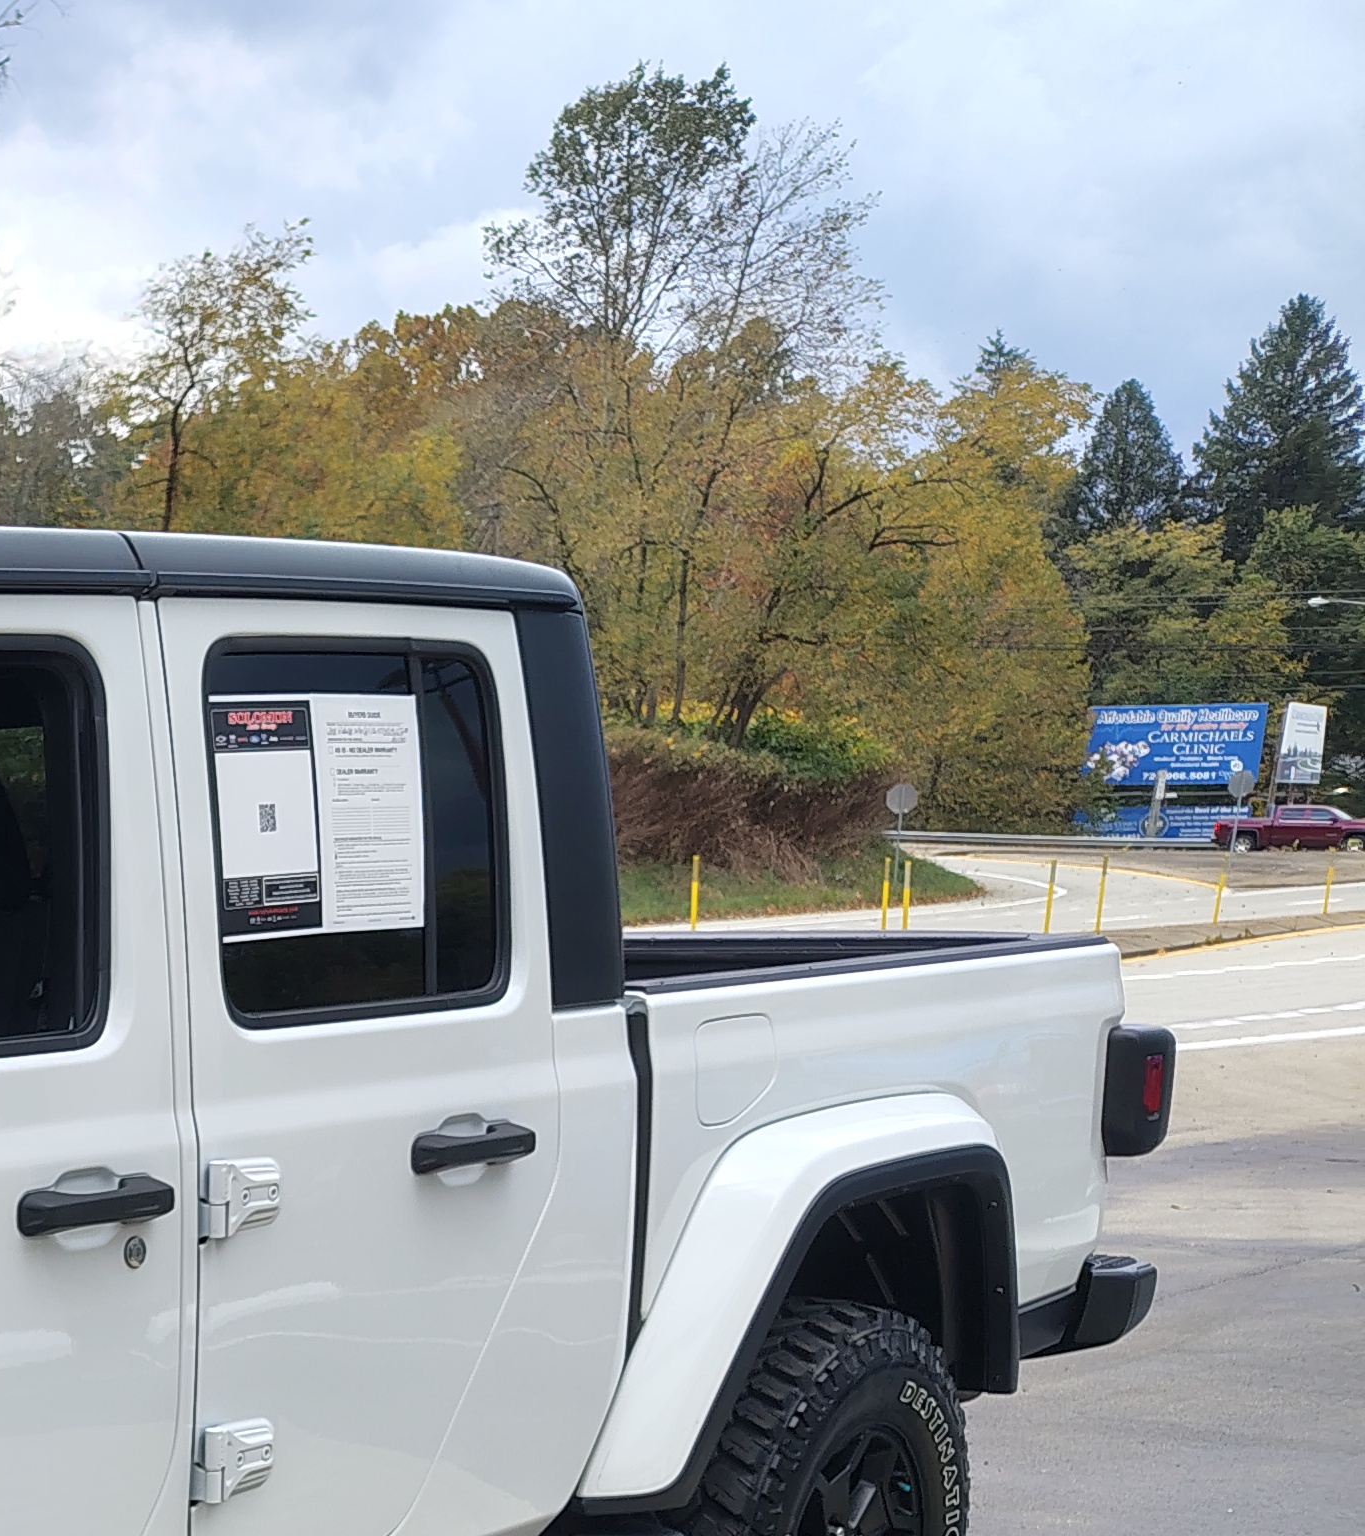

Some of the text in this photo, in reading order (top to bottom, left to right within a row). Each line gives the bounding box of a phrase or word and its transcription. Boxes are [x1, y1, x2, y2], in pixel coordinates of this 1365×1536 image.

[227, 710, 293, 725] SOLOMON
[1096, 708, 1259, 725] Affordable Quality Healthcare
[1147, 730, 1256, 744] CARMICHAELS
[1173, 743, 1226, 756] CLINIC
